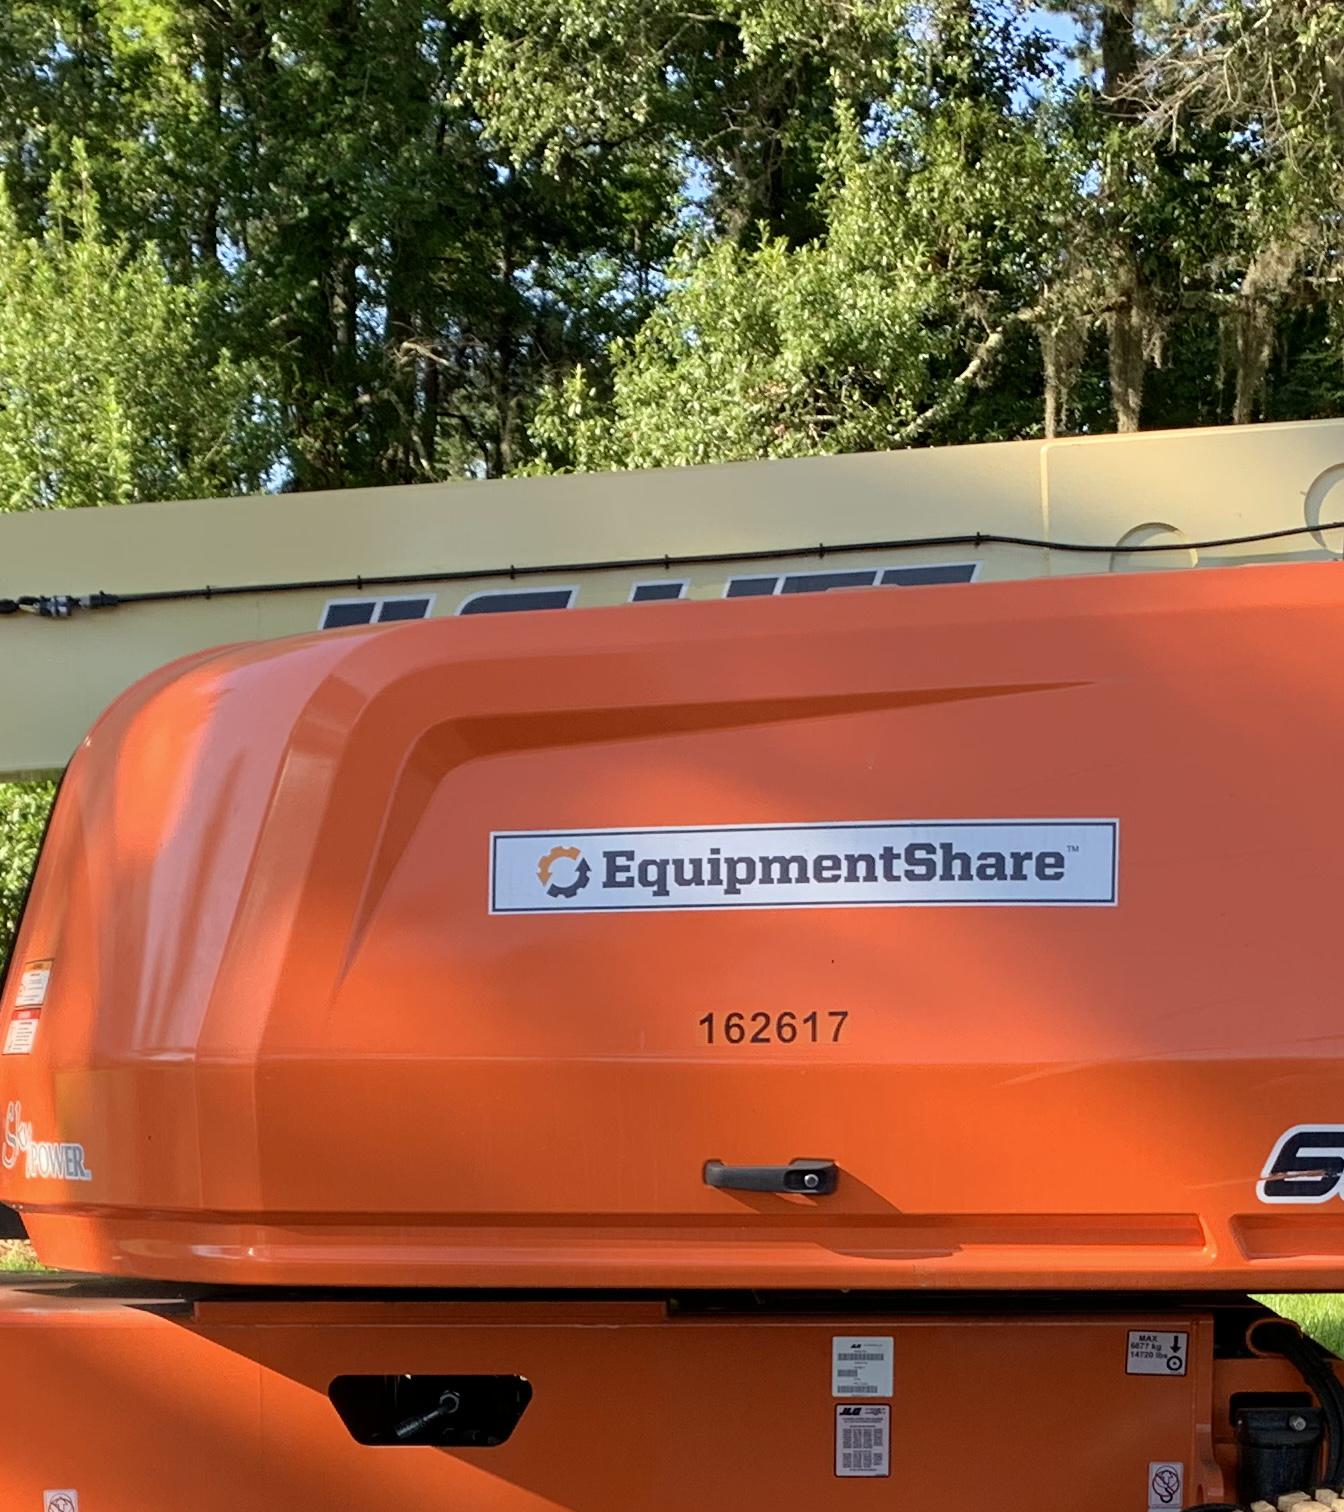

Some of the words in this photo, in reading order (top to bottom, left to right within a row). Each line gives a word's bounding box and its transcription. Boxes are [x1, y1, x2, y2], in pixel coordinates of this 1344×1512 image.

[601, 841, 1065, 897] EquipmentShare
[697, 1010, 850, 1045] 162617
[838, 1407, 862, 1416] JLG
